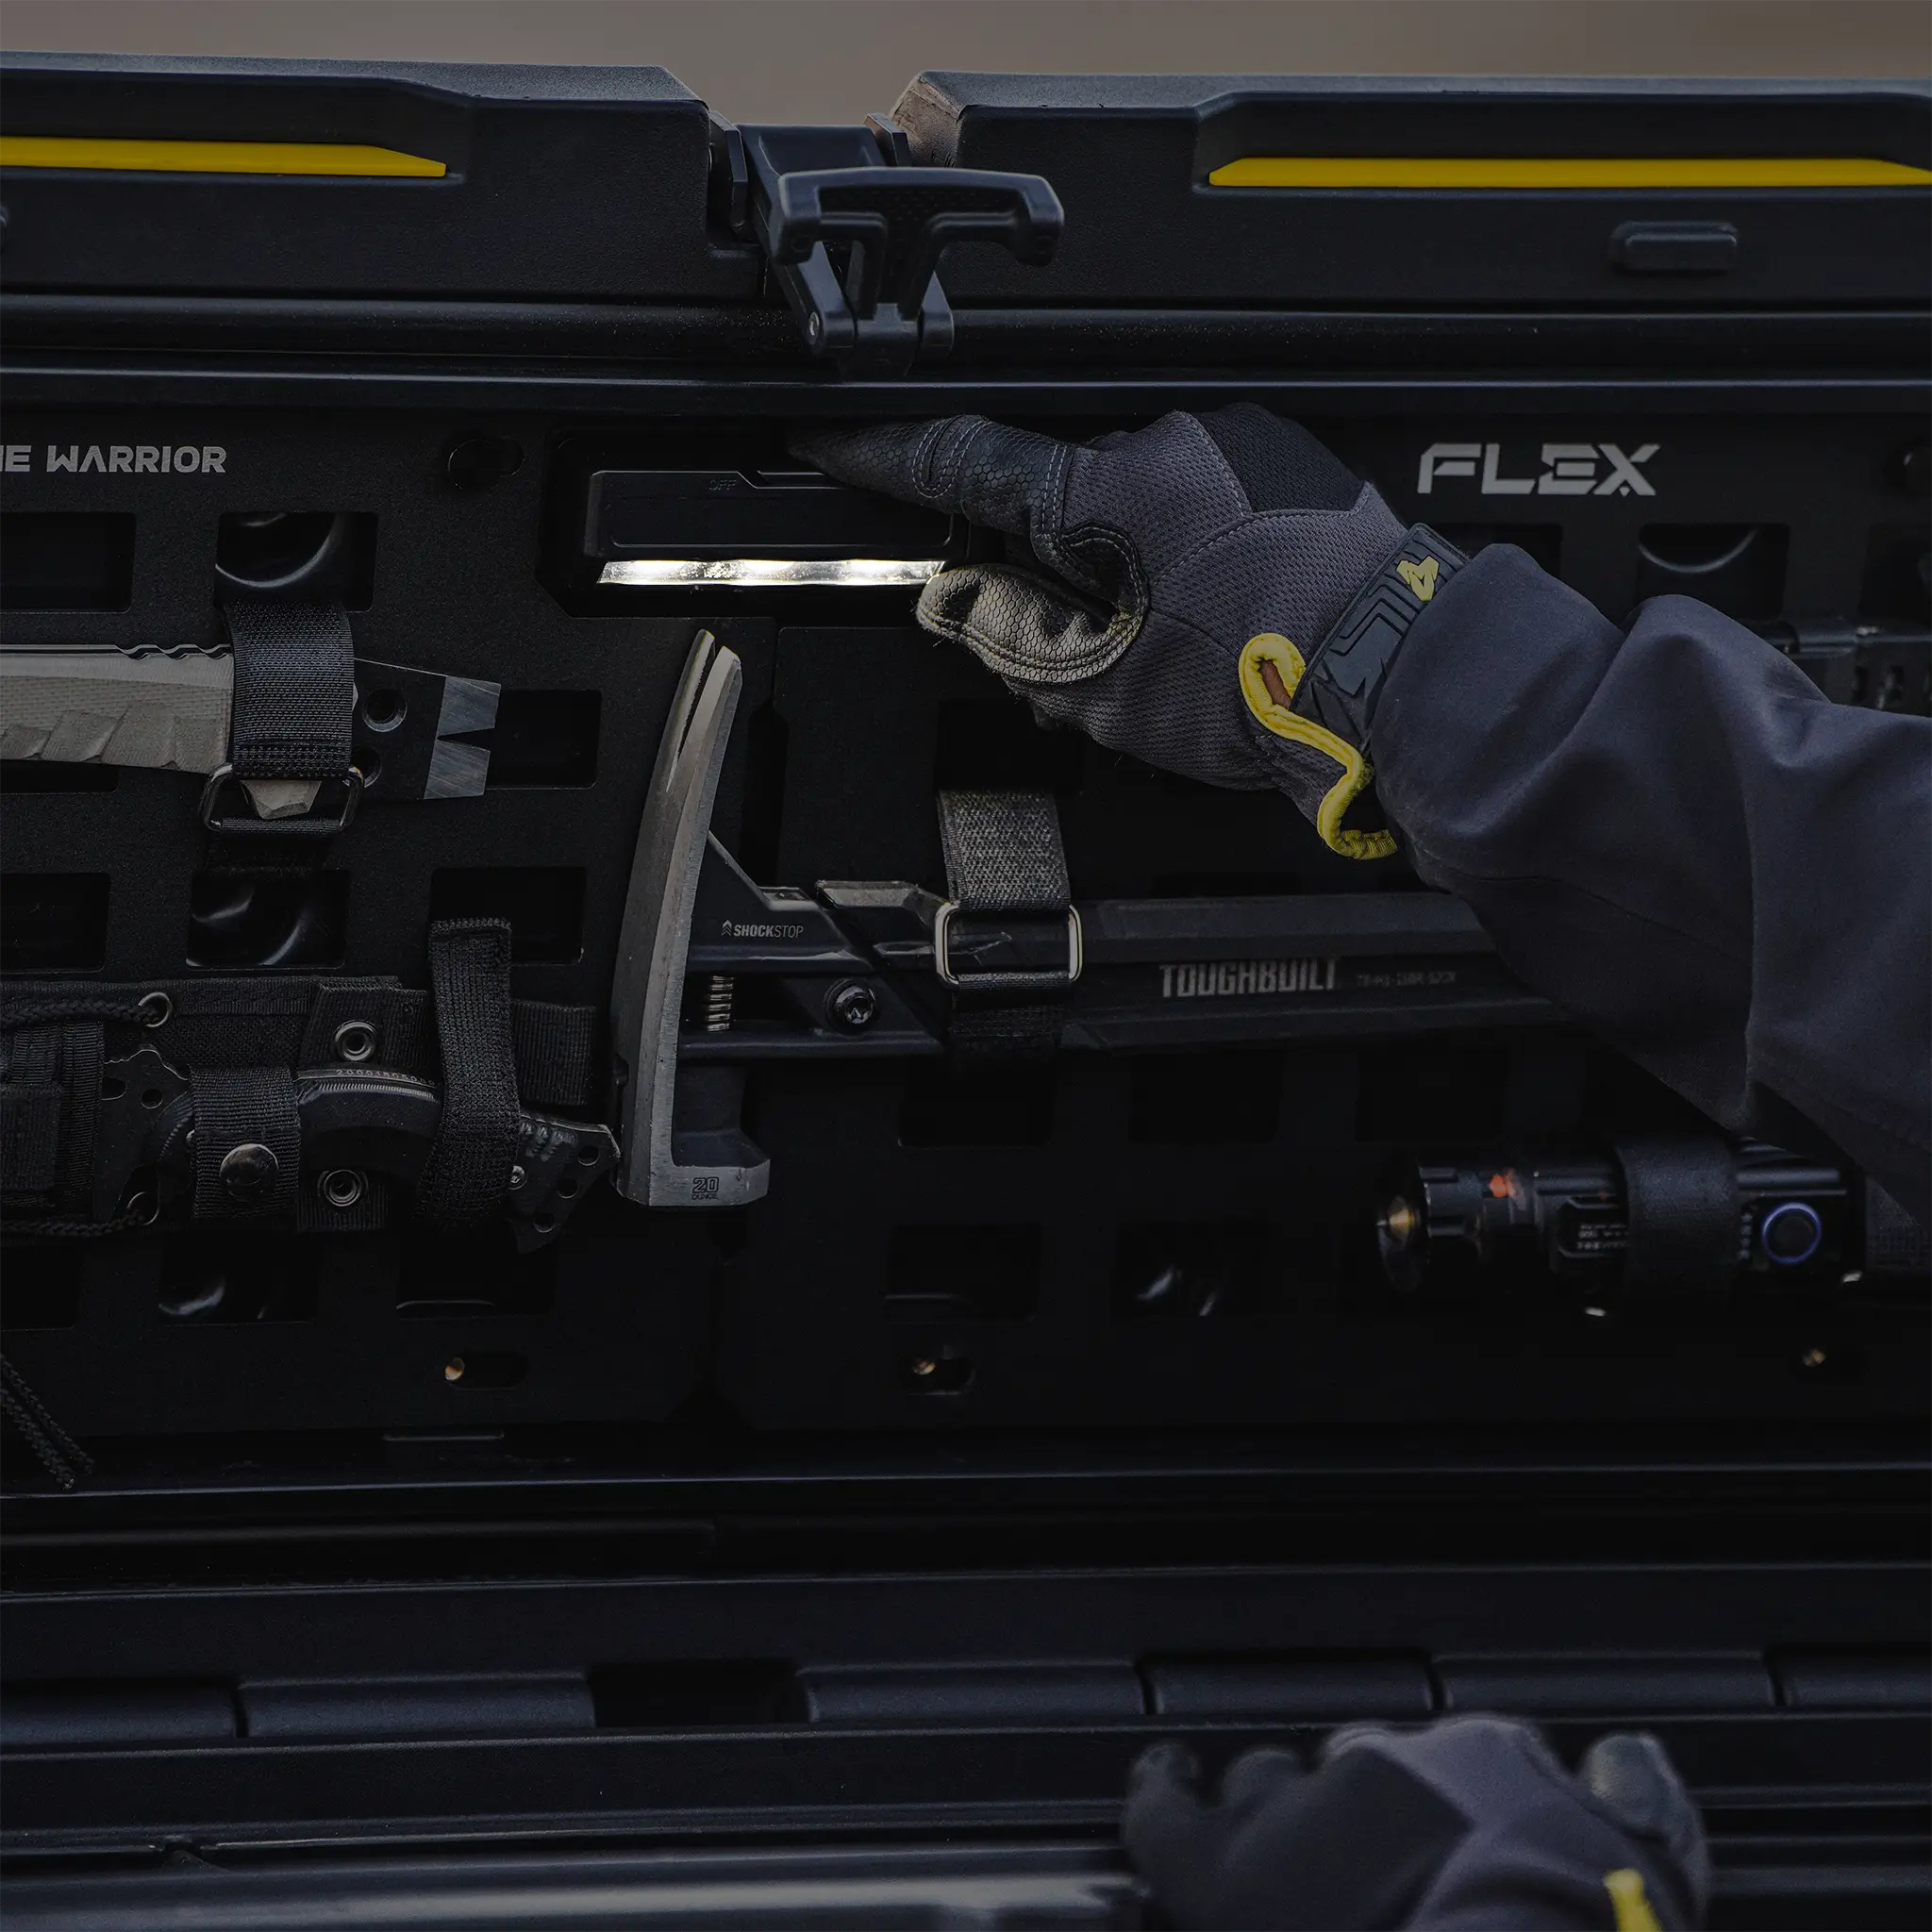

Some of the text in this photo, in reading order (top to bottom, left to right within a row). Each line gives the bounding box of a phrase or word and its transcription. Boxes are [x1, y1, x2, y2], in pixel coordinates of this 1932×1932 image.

[46, 444, 227, 474] WARRIOR
[1417, 442, 1661, 497] FLEX
[733, 924, 804, 939] SHOCKSTOP
[1159, 956, 1338, 998] TOUGHBUILT
[692, 1176, 719, 1193] 20
